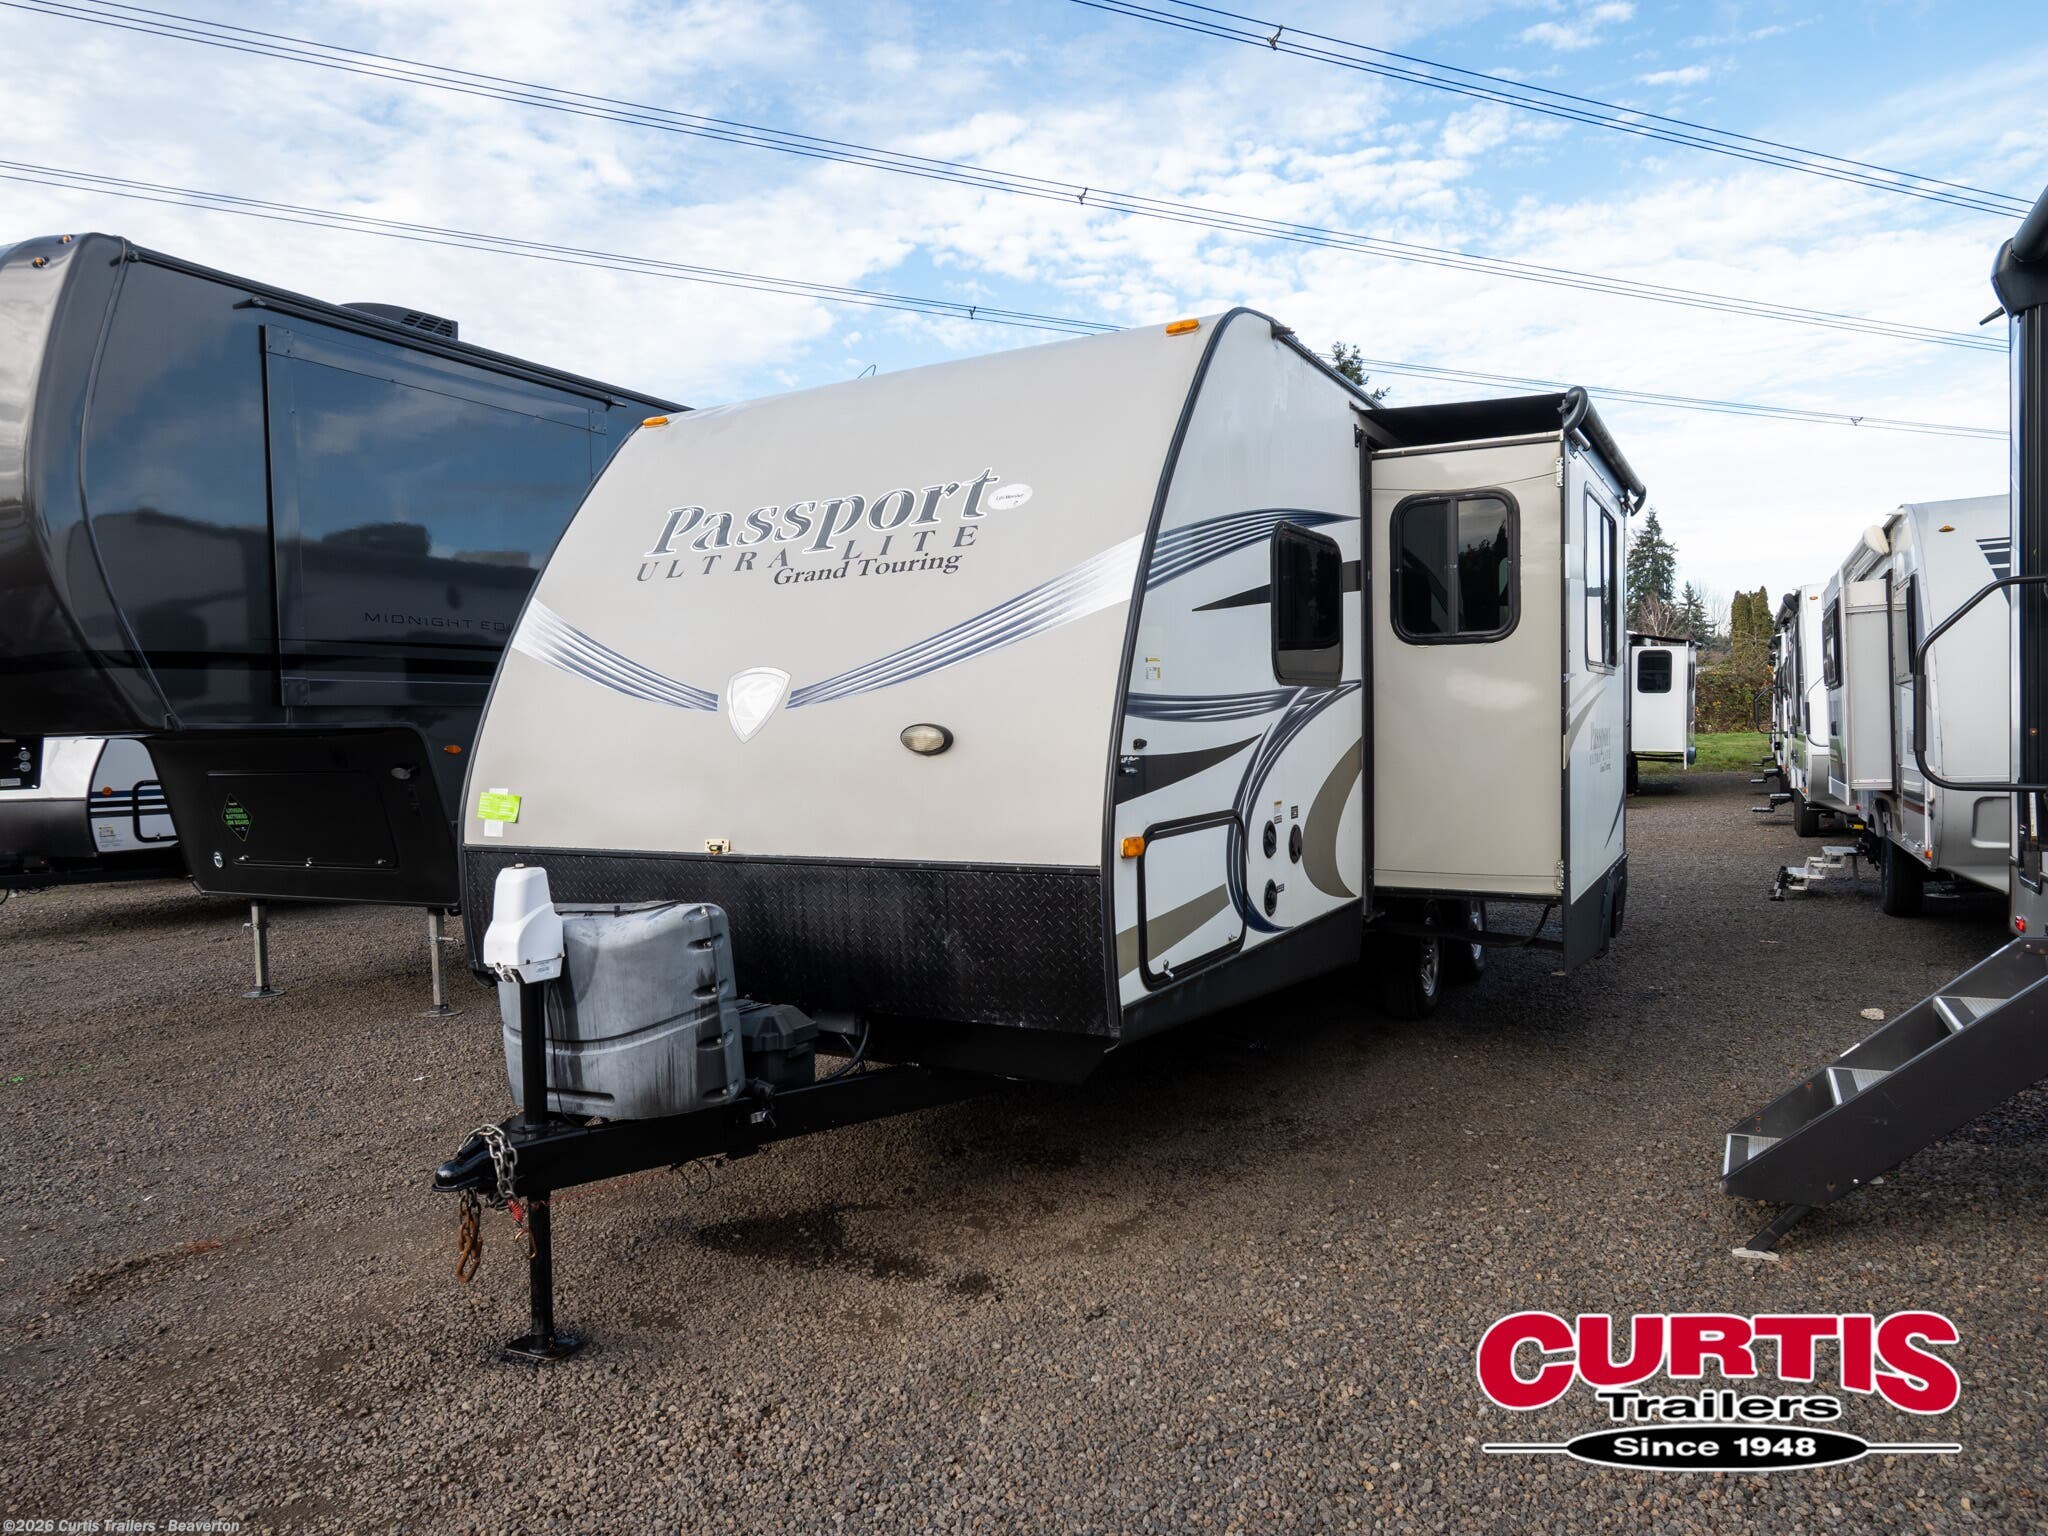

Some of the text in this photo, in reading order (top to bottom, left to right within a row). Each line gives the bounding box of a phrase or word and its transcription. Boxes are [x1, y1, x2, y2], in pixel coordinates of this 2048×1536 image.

[644, 467, 1000, 557] Passport
[636, 525, 979, 582] ULTRA LITE
[773, 552, 963, 586] Grand Touring
[364, 612, 473, 630] MIDNIGHT
